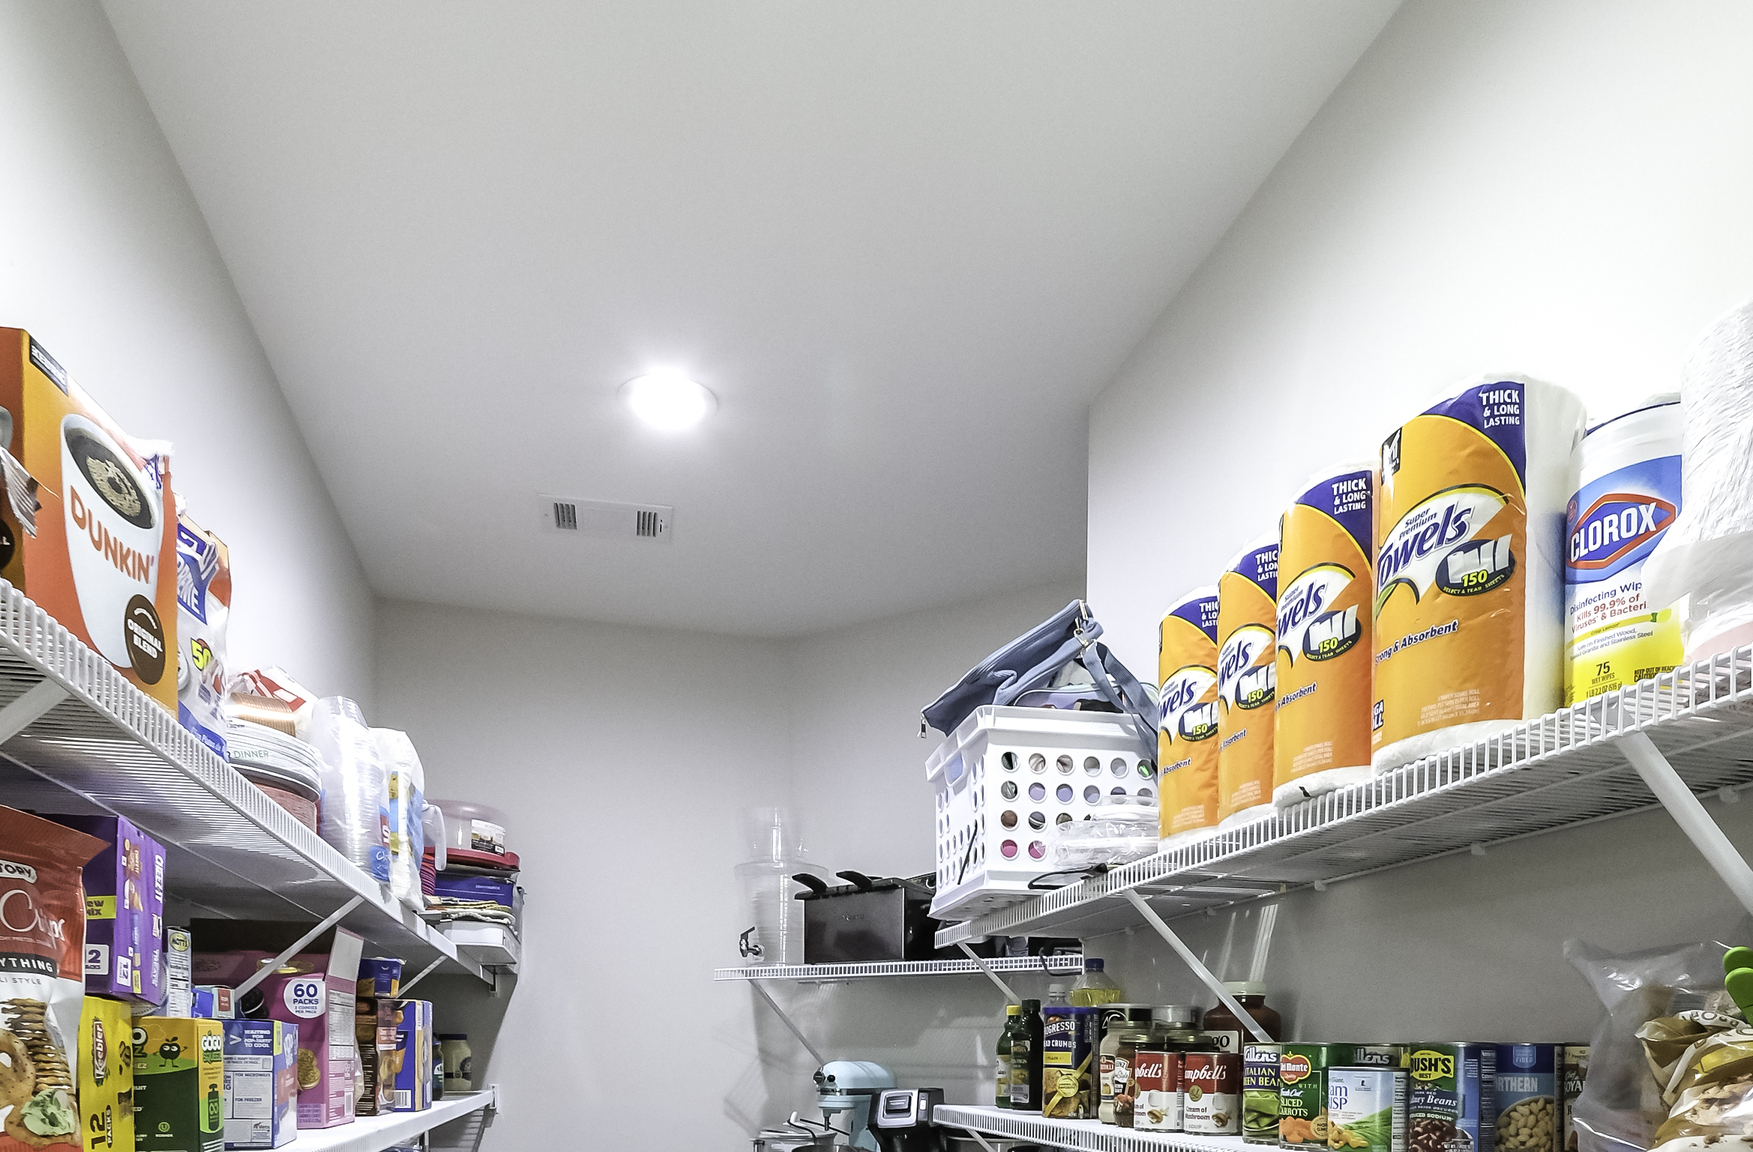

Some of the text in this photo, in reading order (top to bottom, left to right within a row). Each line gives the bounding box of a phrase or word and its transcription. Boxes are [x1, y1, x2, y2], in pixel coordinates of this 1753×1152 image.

[1481, 389, 1520, 405] THICK
[1483, 404, 1520, 417] & LONG
[1484, 416, 1520, 429] LASTING
[1331, 477, 1367, 496] THICK
[1333, 490, 1366, 505] & LONG
[1334, 501, 1366, 515] LASTING
[1399, 511, 1438, 541] Premium
[1405, 507, 1430, 528] Super
[70, 485, 155, 584] DUNKIN'
[1569, 501, 1658, 564] CLOROX
[1377, 503, 1472, 592] Towels
[1461, 570, 1488, 587] 150
[1570, 588, 1617, 616] Disinfecting
[1576, 592, 1641, 623] Kills 99.9% of
[1600, 612, 1607, 621] &
[127, 618, 163, 653] ORIGINAL
[1392, 620, 1458, 653] & Absorbent
[1593, 631, 1616, 645] Finished
[1599, 640, 1610, 649] and
[1610, 634, 1636, 647] Stainless
[1637, 630, 1654, 639] Steel
[133, 633, 158, 659] BLEND
[1318, 637, 1338, 653] 150
[1596, 660, 1611, 677] 75
[1601, 672, 1615, 682] WIPES
[1247, 689, 1264, 703] 150
[1281, 681, 1317, 707] Absorbent
[1192, 723, 1208, 736] 150
[233, 749, 269, 759] DINNER
[293, 983, 318, 998] 60
[95, 1023, 104, 1080] Keebler
[1051, 1039, 1077, 1049] CRUMBS
[1285, 1062, 1308, 1072] Monte
[1426, 1094, 1458, 1108] Beans
[90, 1111, 106, 1150] 12
